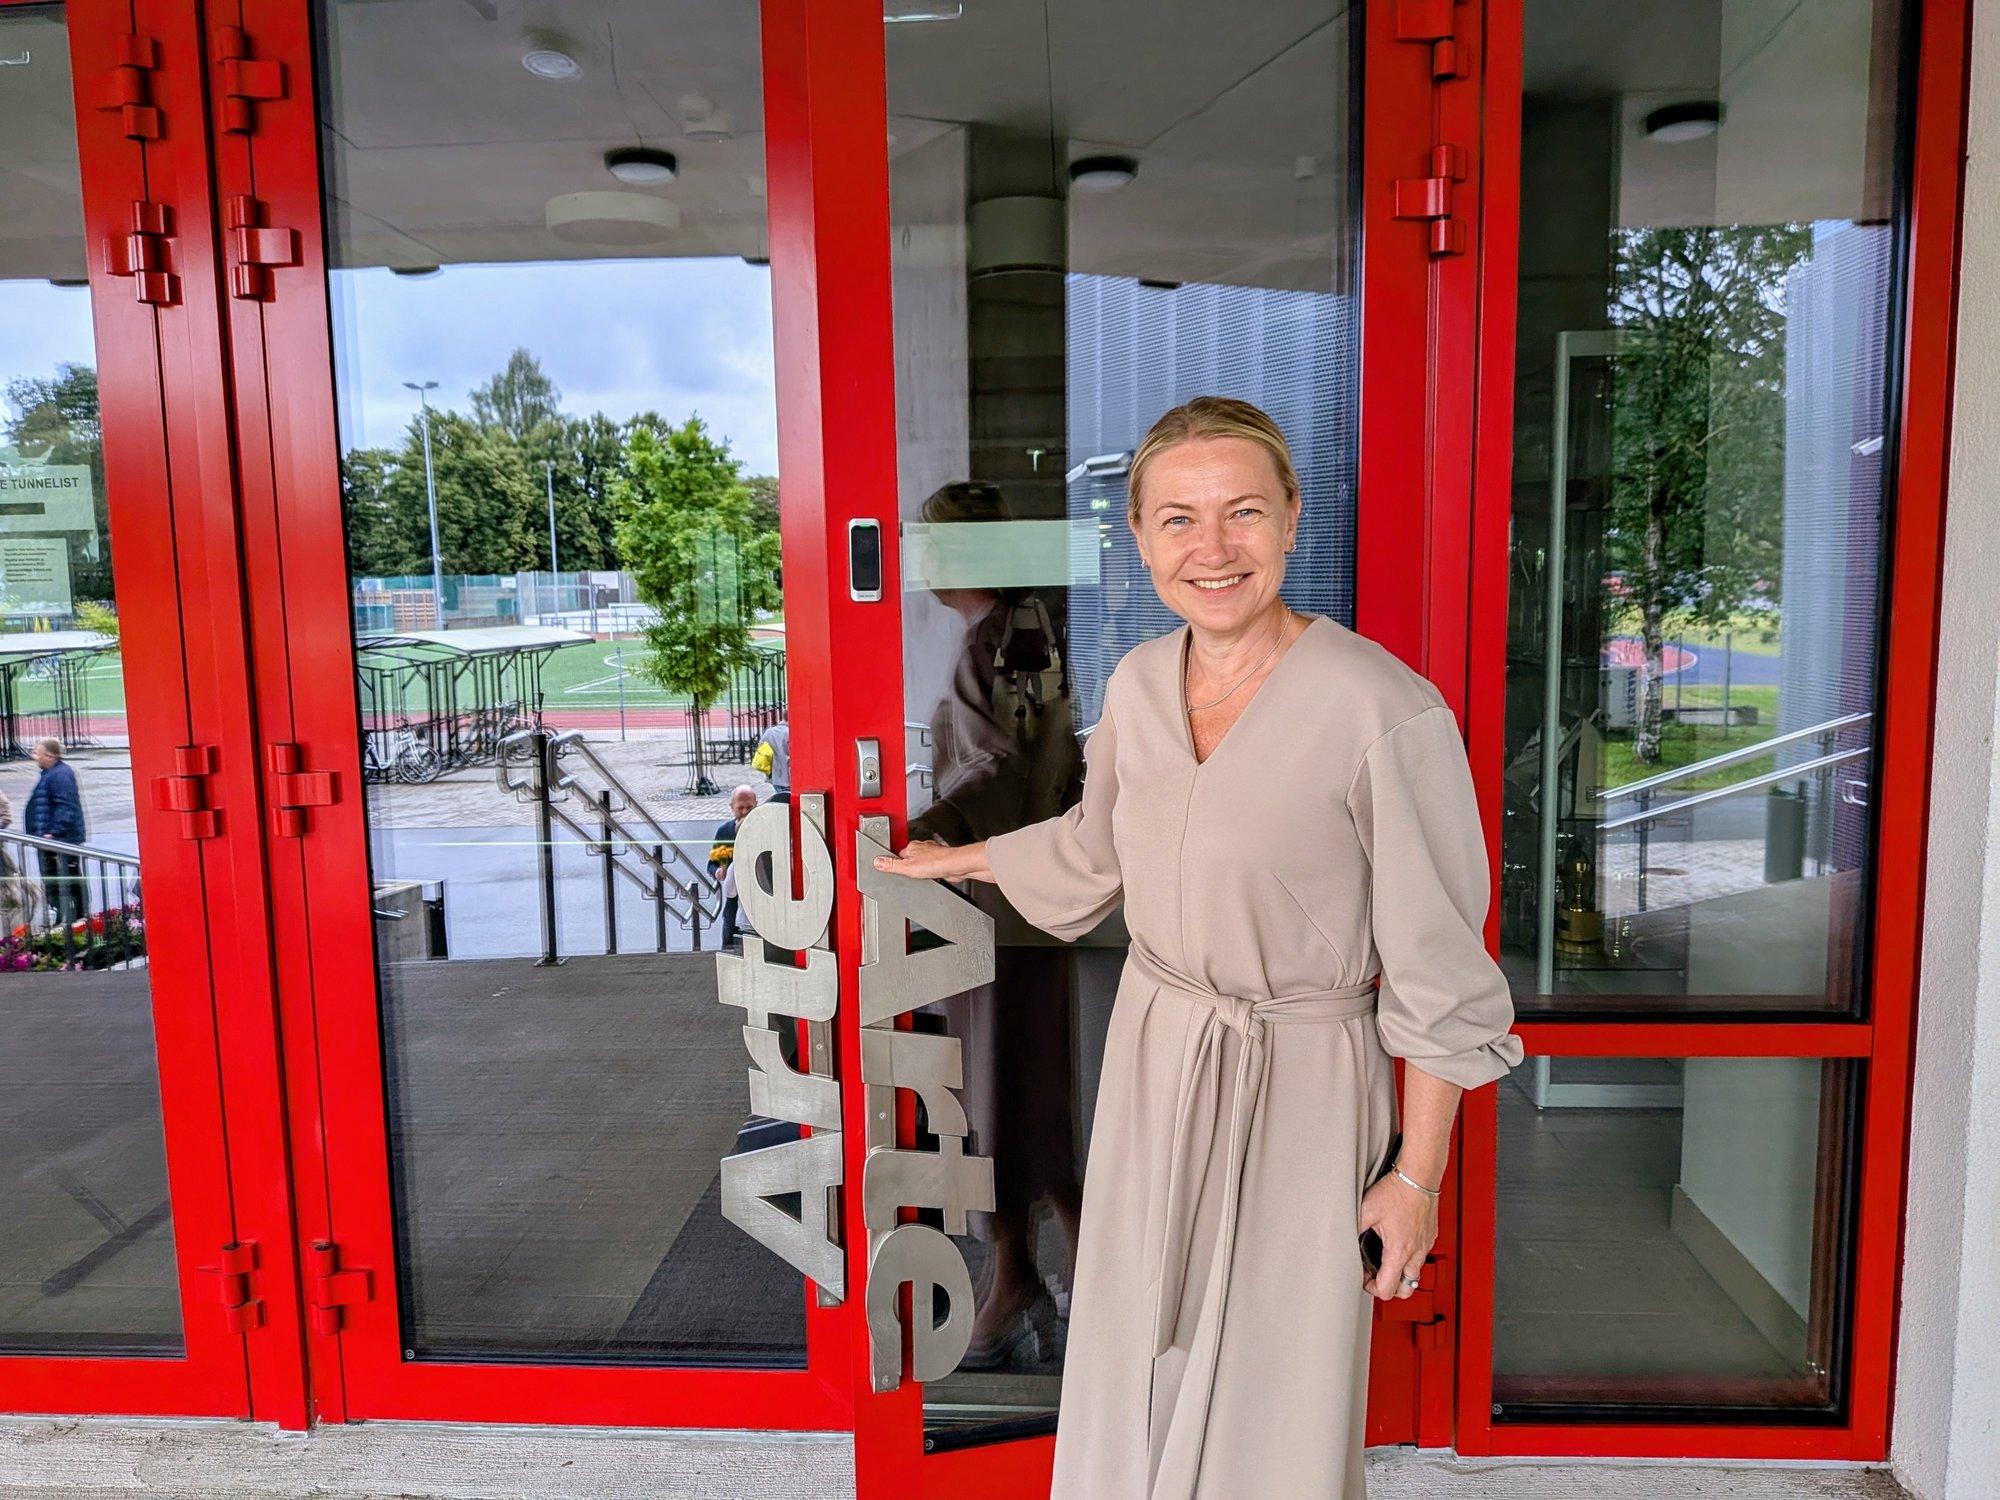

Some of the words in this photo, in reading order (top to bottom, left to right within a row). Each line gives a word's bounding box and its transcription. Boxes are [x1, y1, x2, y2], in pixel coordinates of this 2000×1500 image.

[11, 477, 79, 489] TUNNELIST
[716, 803, 845, 1303] Arte
[856, 830, 996, 1383] Arte
